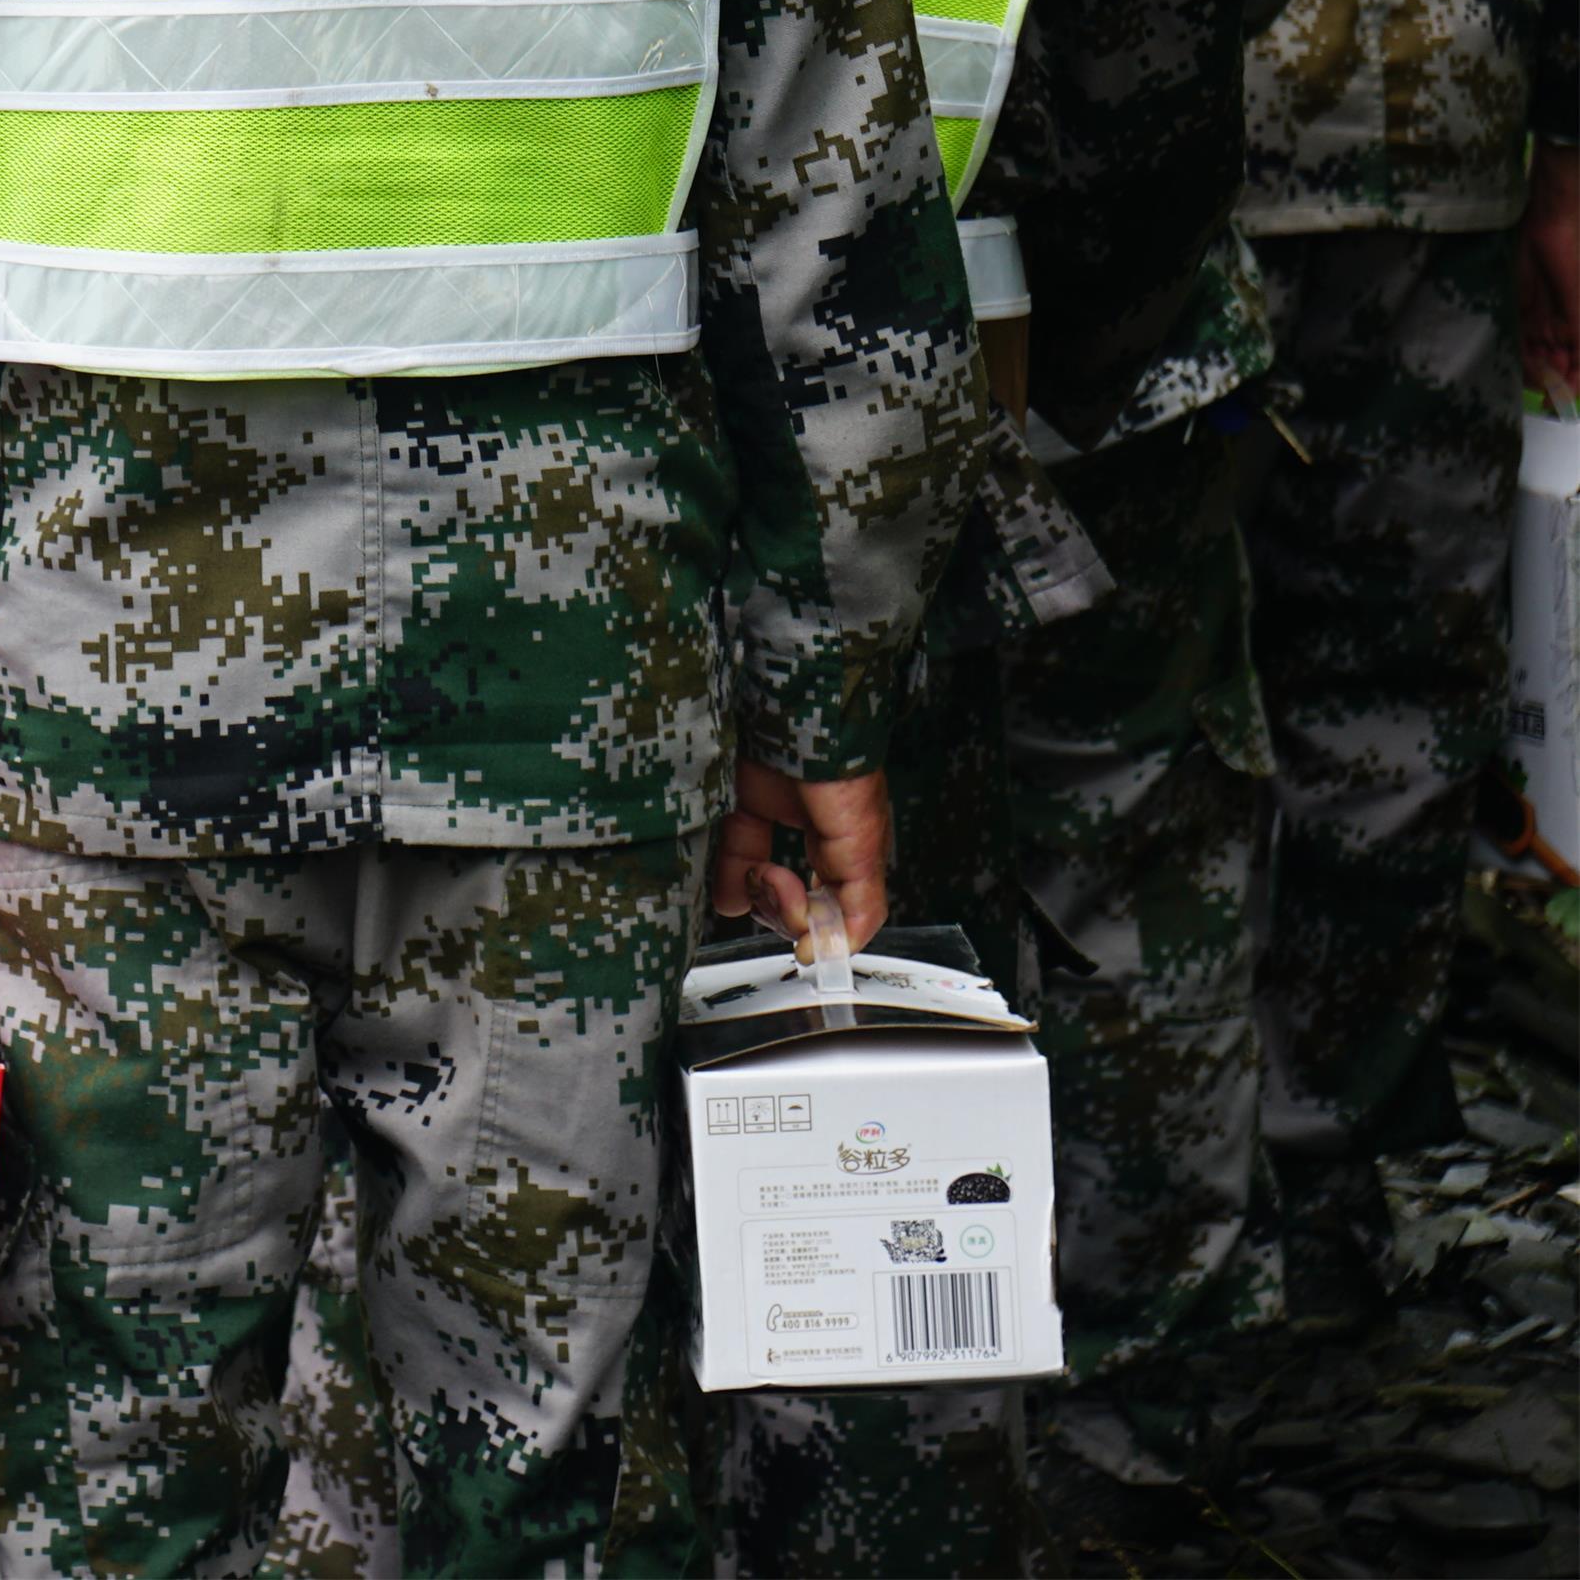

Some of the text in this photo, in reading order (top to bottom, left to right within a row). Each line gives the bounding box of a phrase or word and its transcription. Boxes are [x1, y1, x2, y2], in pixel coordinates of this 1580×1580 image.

[859, 1127, 881, 1137] 伊利
[839, 1144, 912, 1173] 谷粒多
